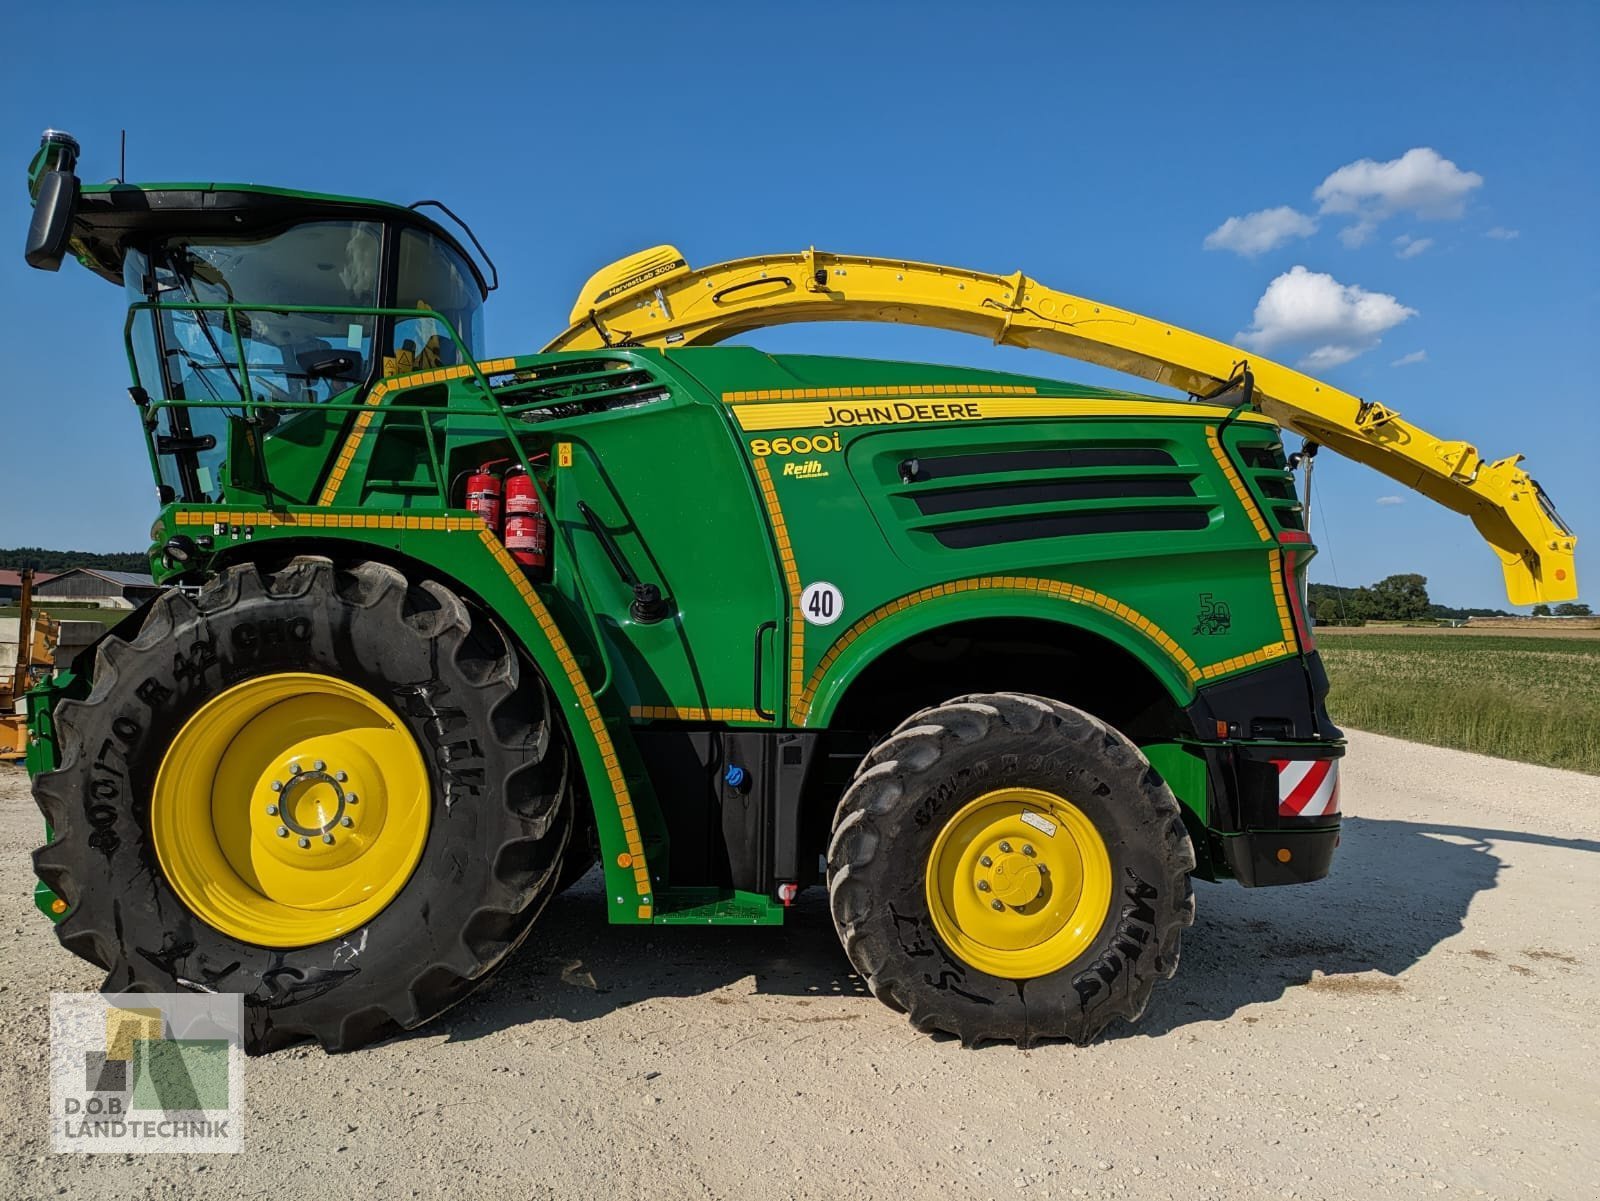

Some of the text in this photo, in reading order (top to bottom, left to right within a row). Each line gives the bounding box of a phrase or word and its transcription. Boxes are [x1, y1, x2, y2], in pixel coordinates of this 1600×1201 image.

[608, 263, 676, 296] HarvestLab 3000
[824, 403, 982, 425] JOHN DEERE
[750, 431, 842, 457] 8600i
[808, 590, 833, 618] 40
